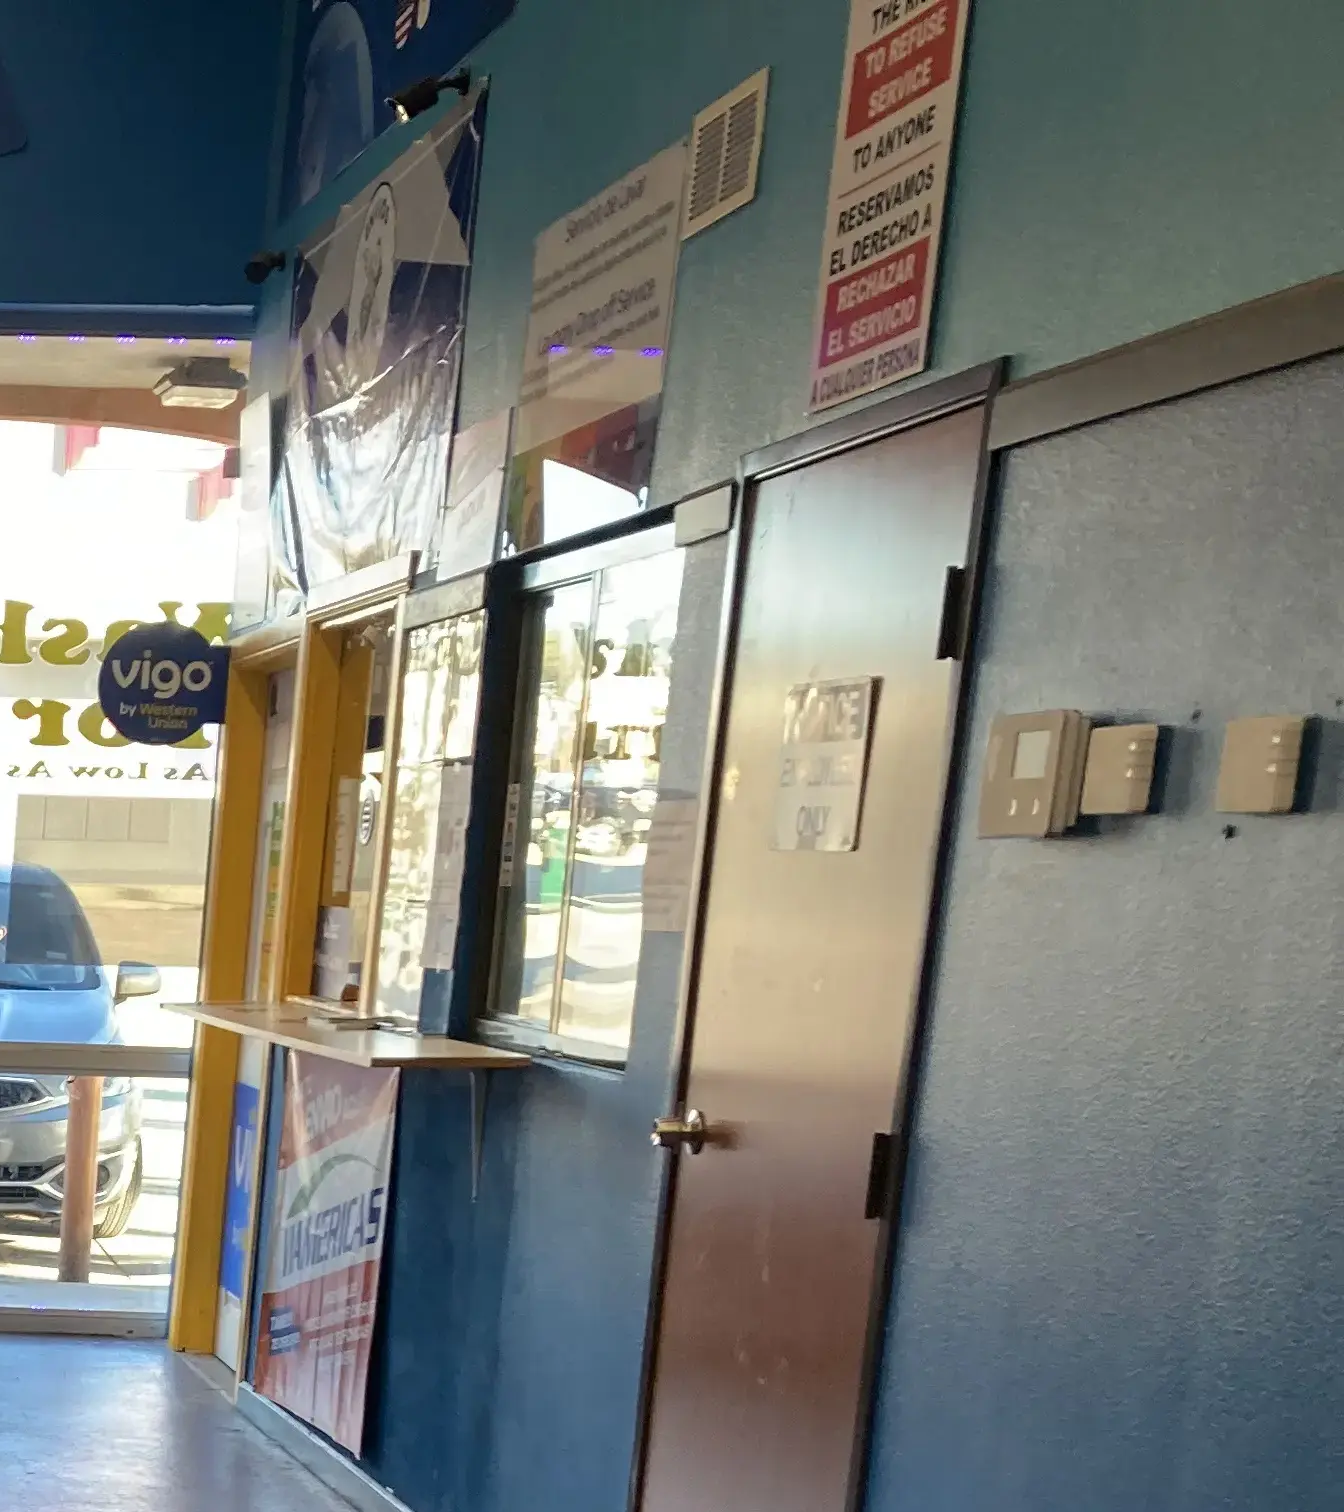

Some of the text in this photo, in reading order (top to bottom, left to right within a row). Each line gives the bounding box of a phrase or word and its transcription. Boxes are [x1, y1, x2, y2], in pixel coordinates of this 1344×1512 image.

[865, 6, 950, 78] TO REFUSE
[873, 1, 899, 34] THE
[868, 56, 934, 118] SERVICE
[853, 104, 937, 173] TO ANYONE
[837, 163, 935, 237] RESERVAMOS
[829, 202, 932, 276] EL DERECHO A
[836, 253, 916, 313] RECHAZAR
[827, 295, 917, 357] EL SERVICIO
[112, 649, 212, 699] vigo
[119, 701, 198, 718] by Western
[148, 716, 188, 729] Union
